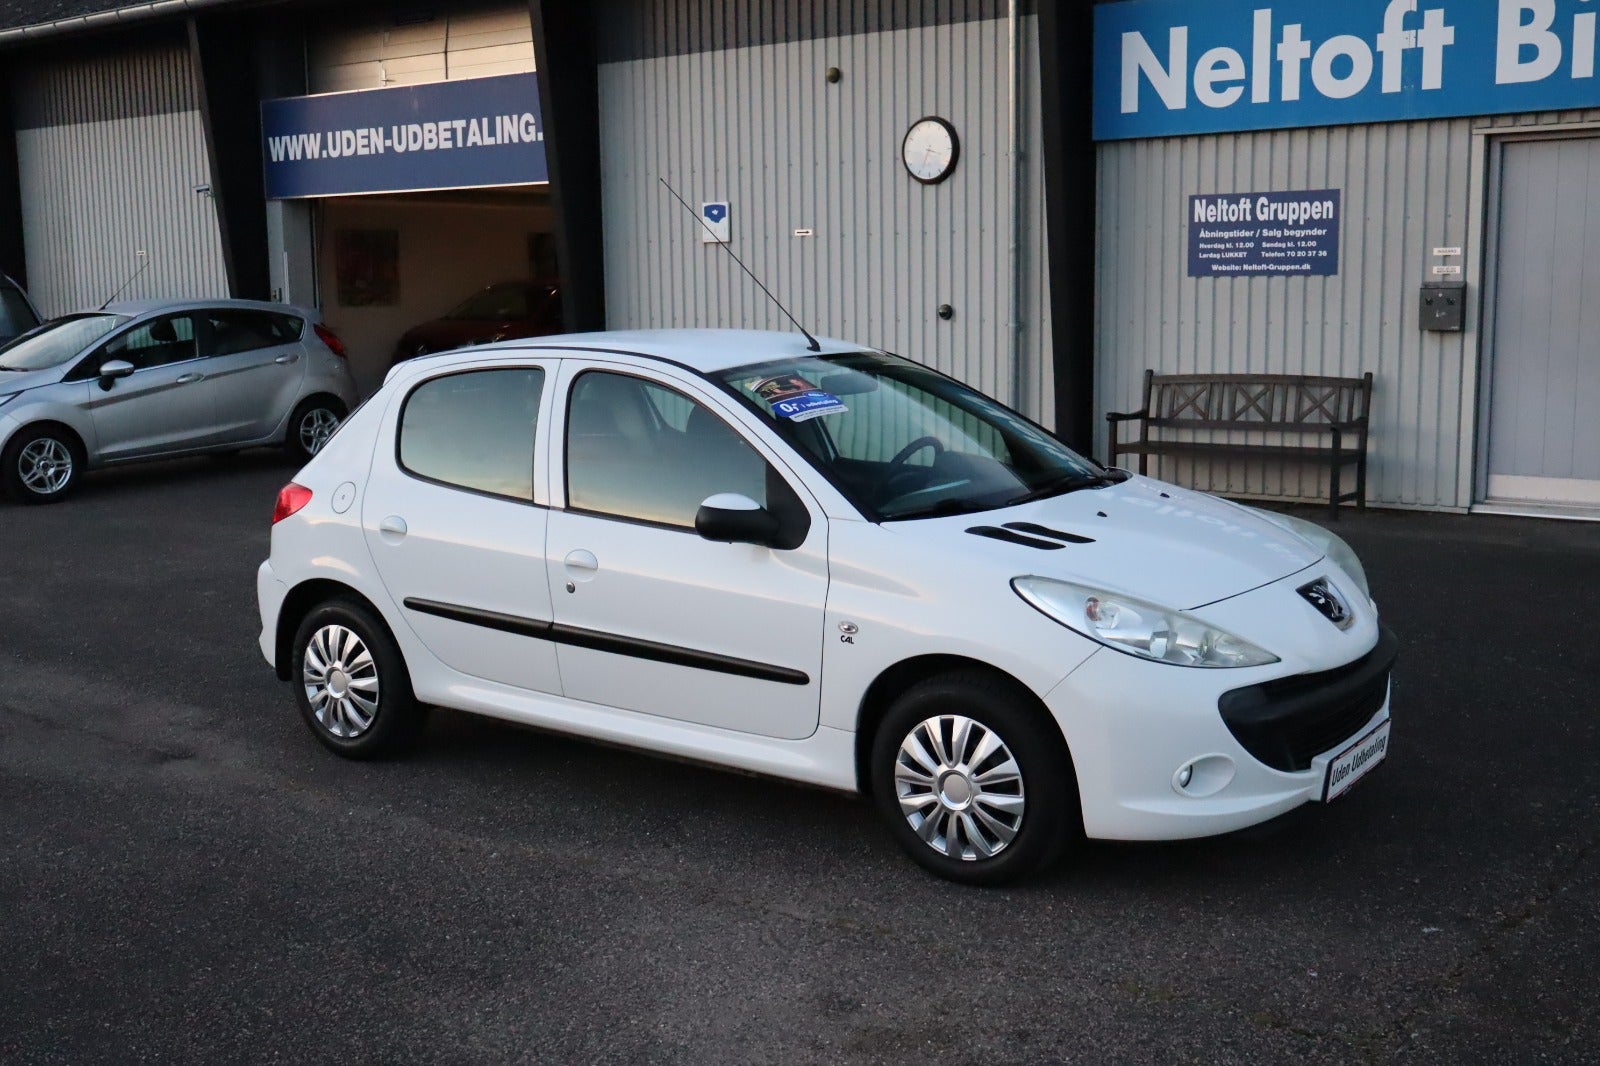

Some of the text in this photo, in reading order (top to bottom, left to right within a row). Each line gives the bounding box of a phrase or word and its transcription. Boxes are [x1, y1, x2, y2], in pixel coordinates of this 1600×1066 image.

[1121, 0, 1597, 113] Neltoft Bi
[269, 112, 543, 162] WWW.UDEN-UDBETALING.
[1194, 196, 1334, 225] Neltoft Gruppen
[1199, 227, 1327, 239] Åbningstider / Salg begynder
[1235, 241, 1255, 249] 12.00
[1297, 240, 1317, 248] 12.00
[1211, 263, 1311, 272] Website: Neltoft-Gruppen.dk
[1331, 735, 1387, 787] Uden Udbetaling
